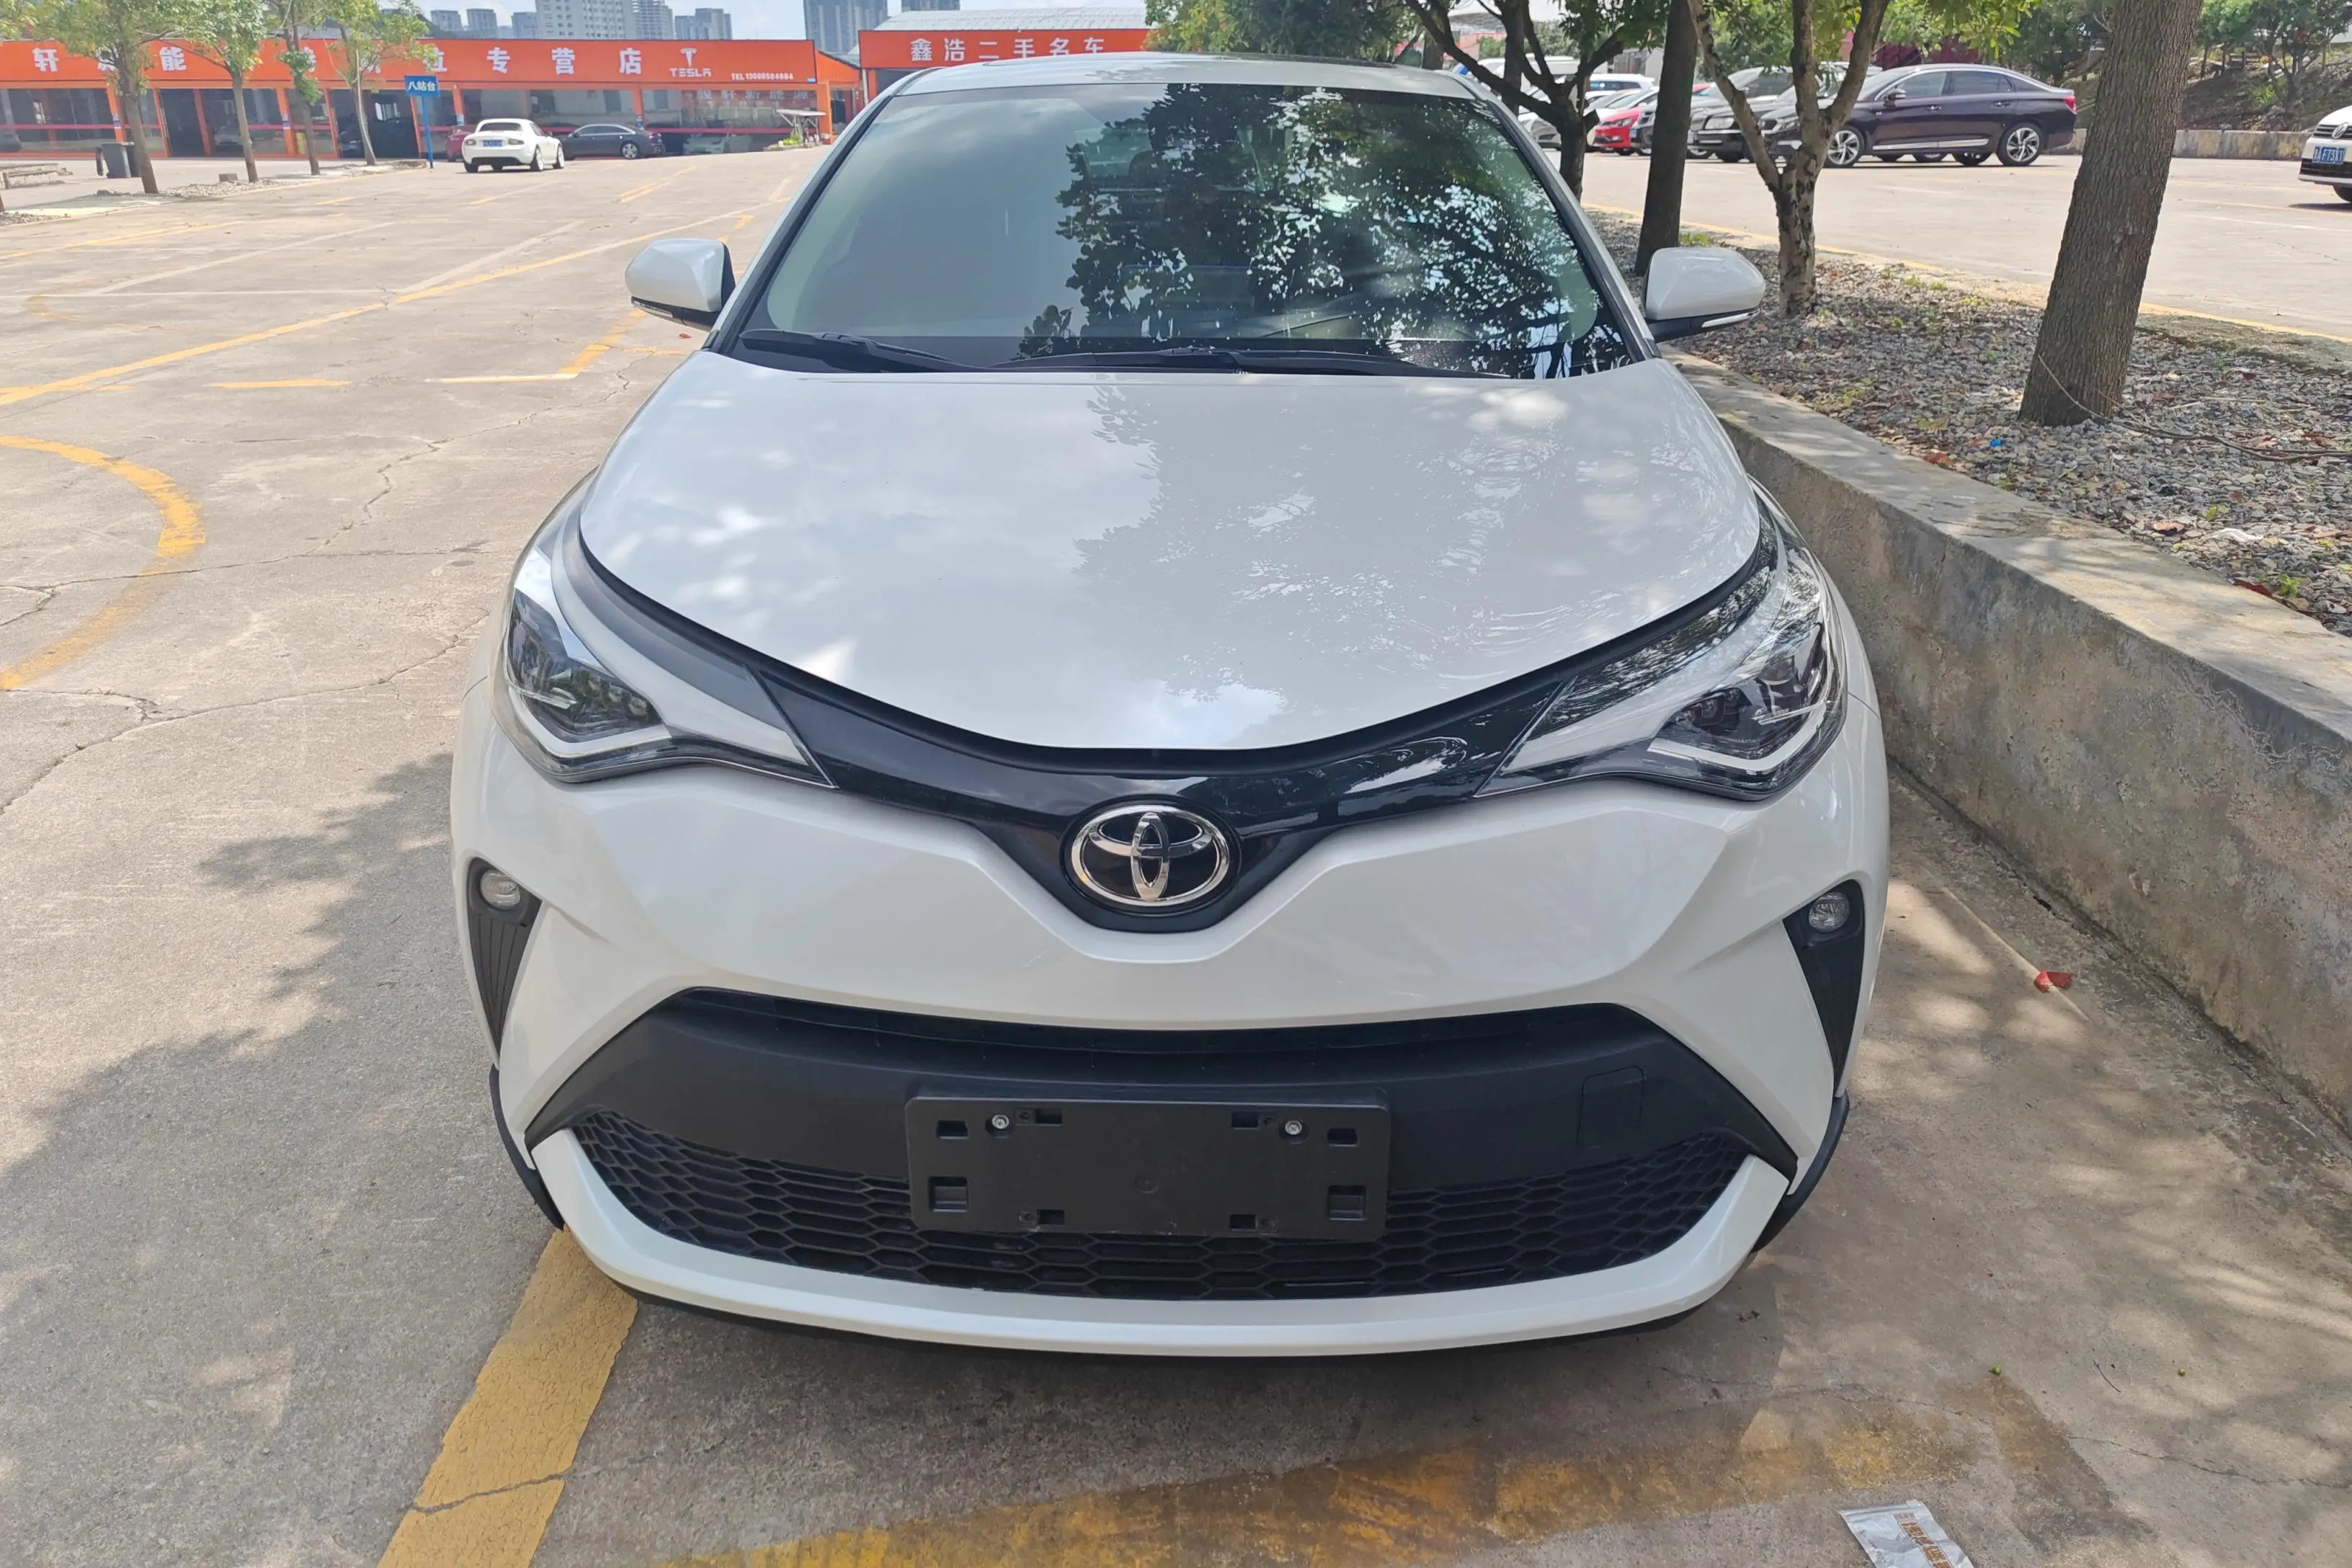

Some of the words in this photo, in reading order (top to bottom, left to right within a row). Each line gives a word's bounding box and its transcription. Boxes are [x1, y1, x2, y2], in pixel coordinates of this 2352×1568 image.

[910, 37, 1104, 61] 鑫浩二手名车
[669, 68, 712, 77] TESLA
[408, 81, 436, 92] 八站台
